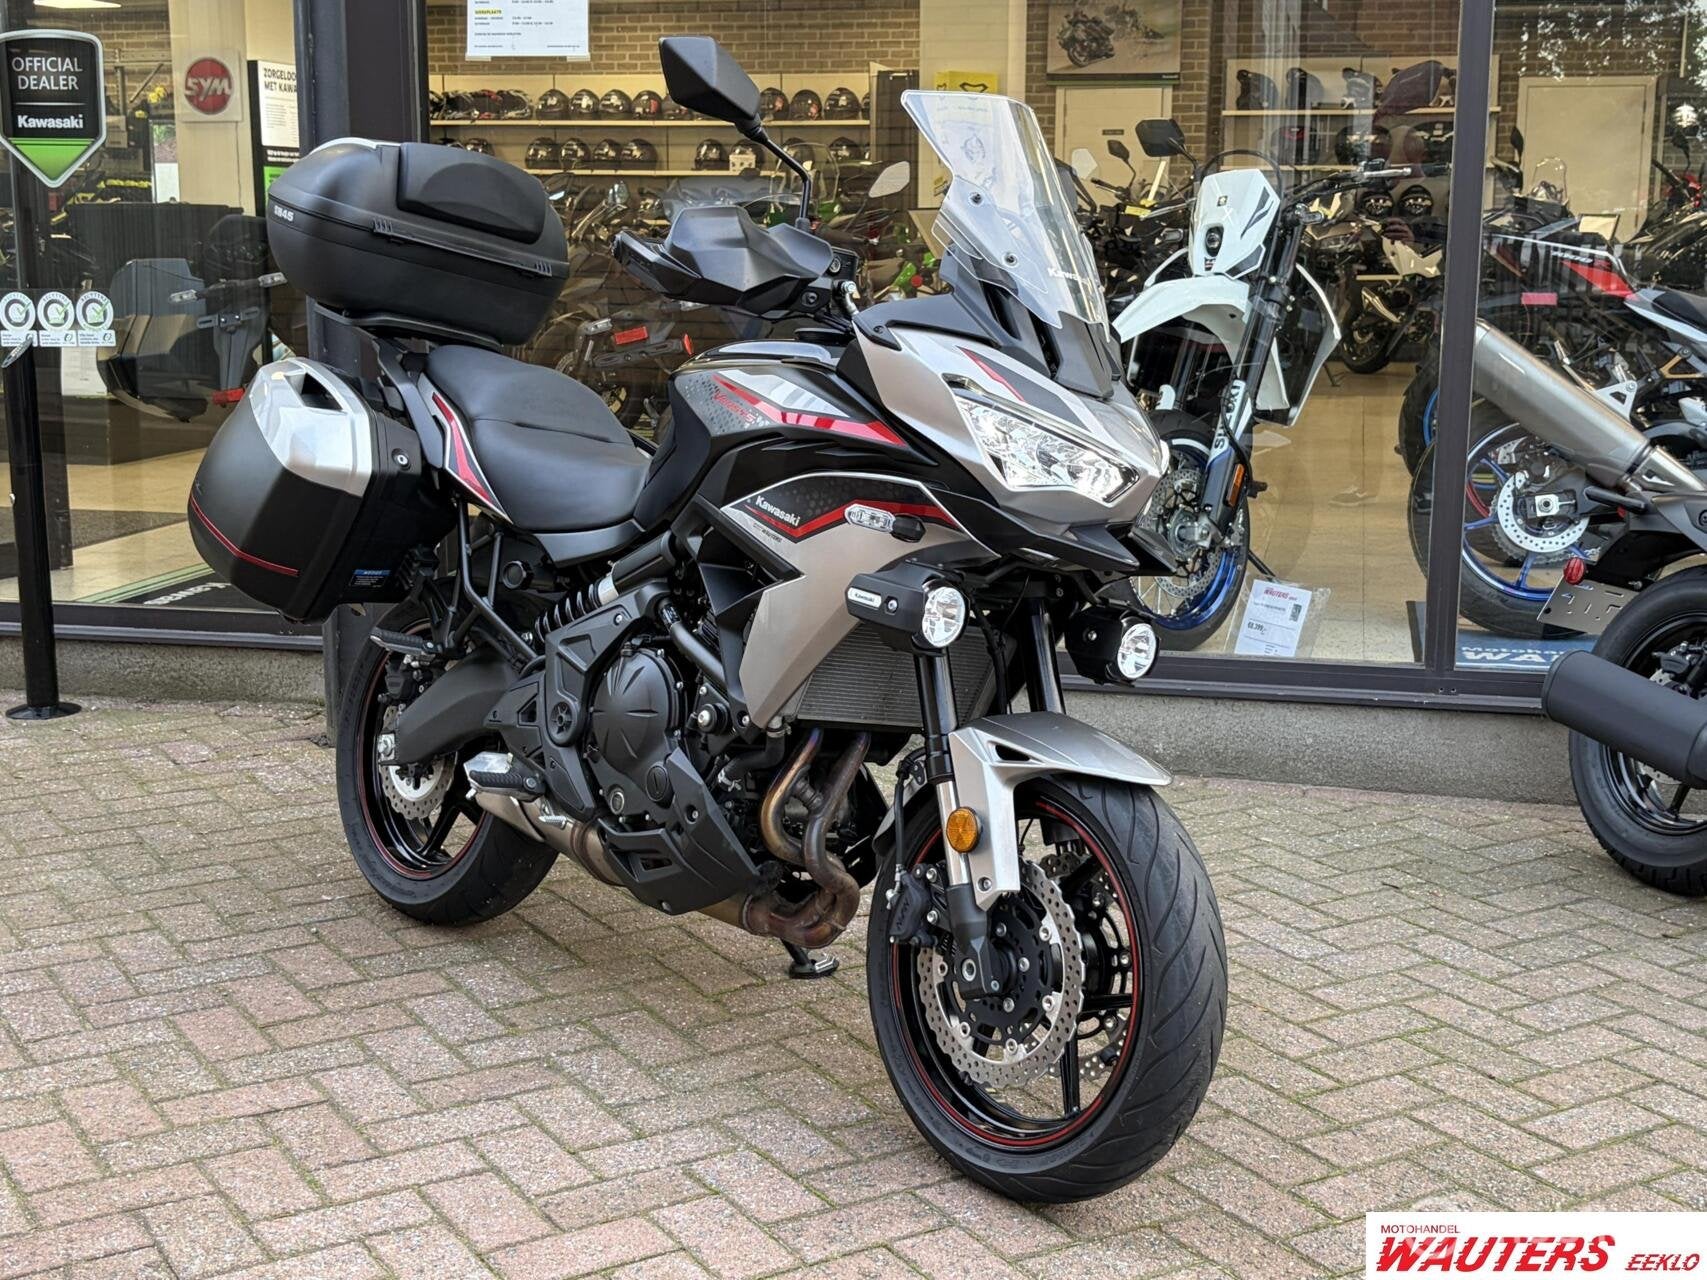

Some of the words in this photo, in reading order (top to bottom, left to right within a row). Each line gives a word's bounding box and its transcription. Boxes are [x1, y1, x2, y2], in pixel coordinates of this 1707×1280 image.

[12, 57, 83, 73] OFFICIAL
[18, 76, 79, 90] DEALER
[185, 76, 231, 101] SYM
[264, 81, 277, 91] MET
[18, 114, 83, 129] Kawasaki
[755, 495, 801, 527] Kawasaki
